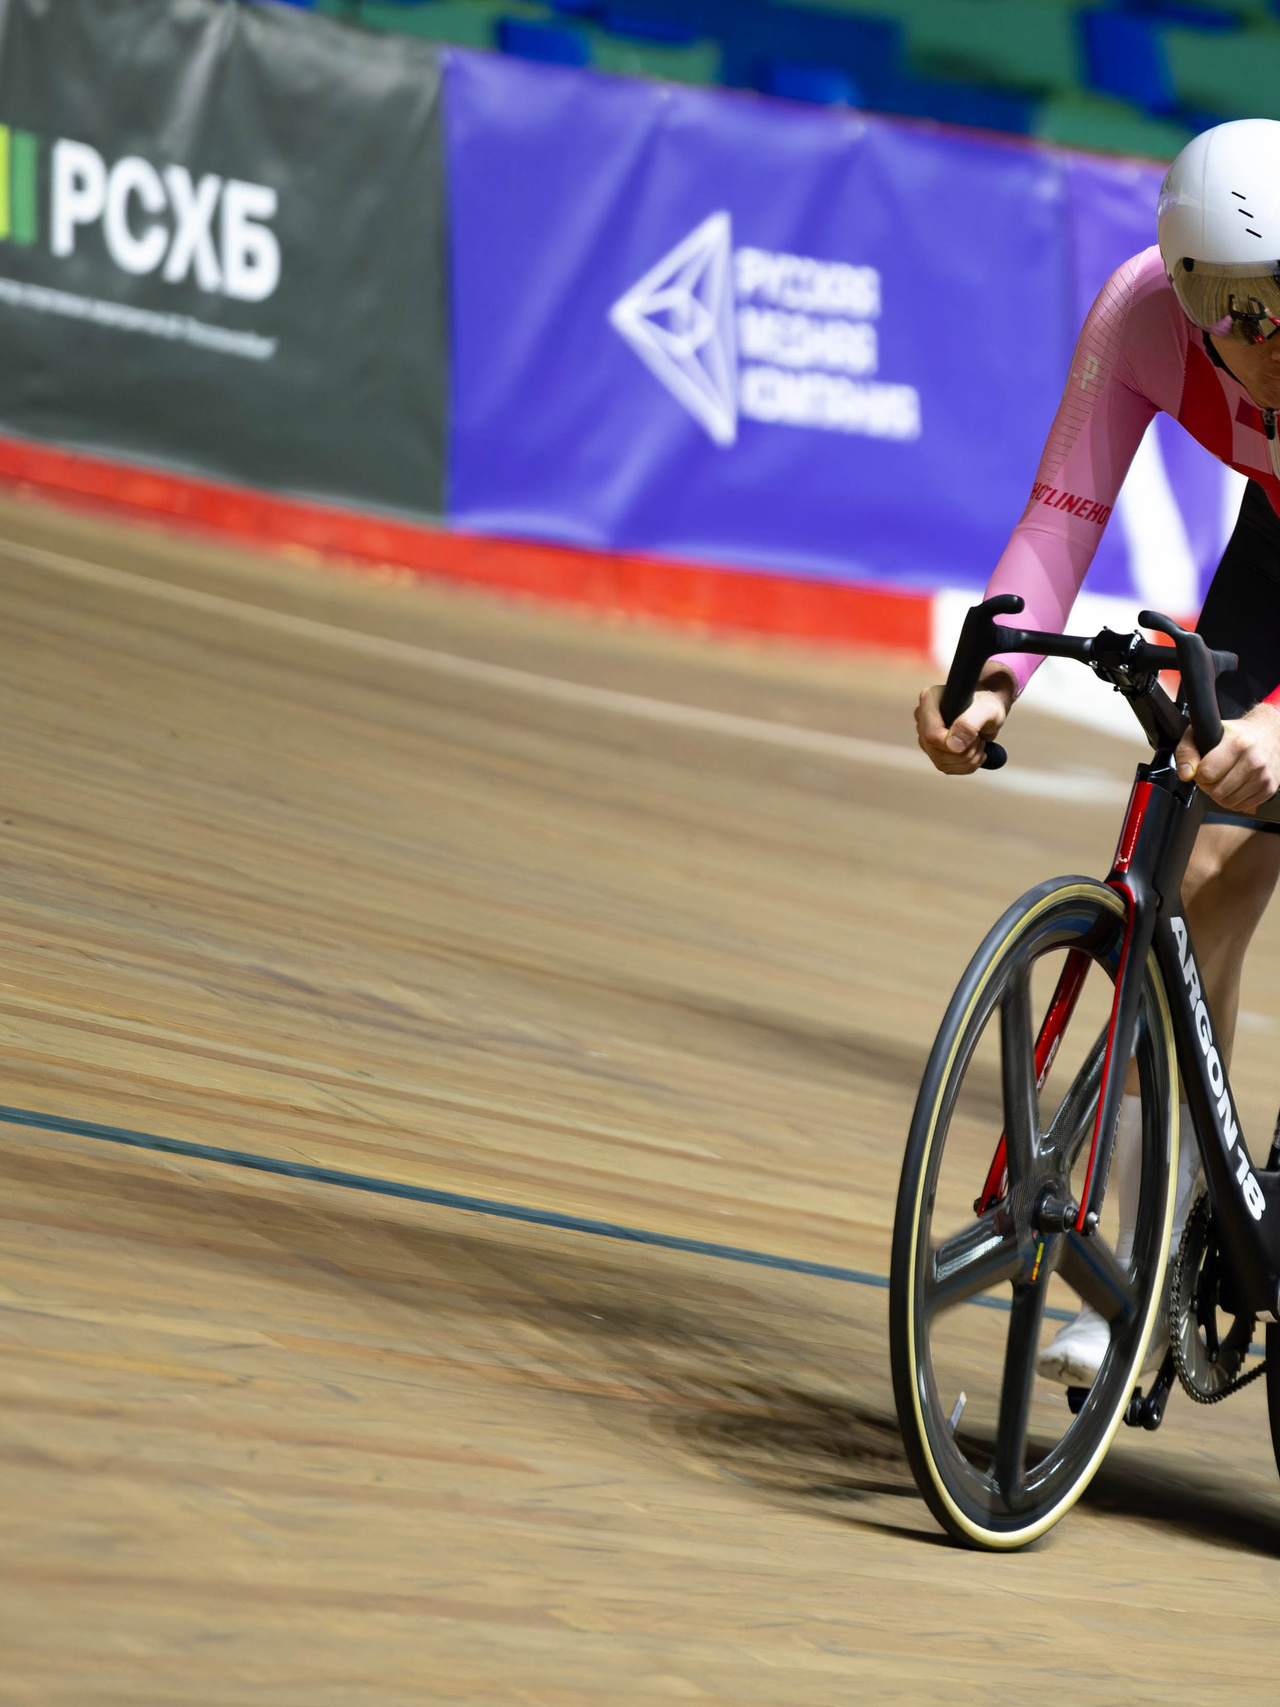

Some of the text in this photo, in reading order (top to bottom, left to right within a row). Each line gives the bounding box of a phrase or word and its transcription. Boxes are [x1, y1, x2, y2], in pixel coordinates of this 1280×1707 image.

[52, 136, 282, 303] РСХБ
[1170, 916, 1266, 1221] ARGON 18
